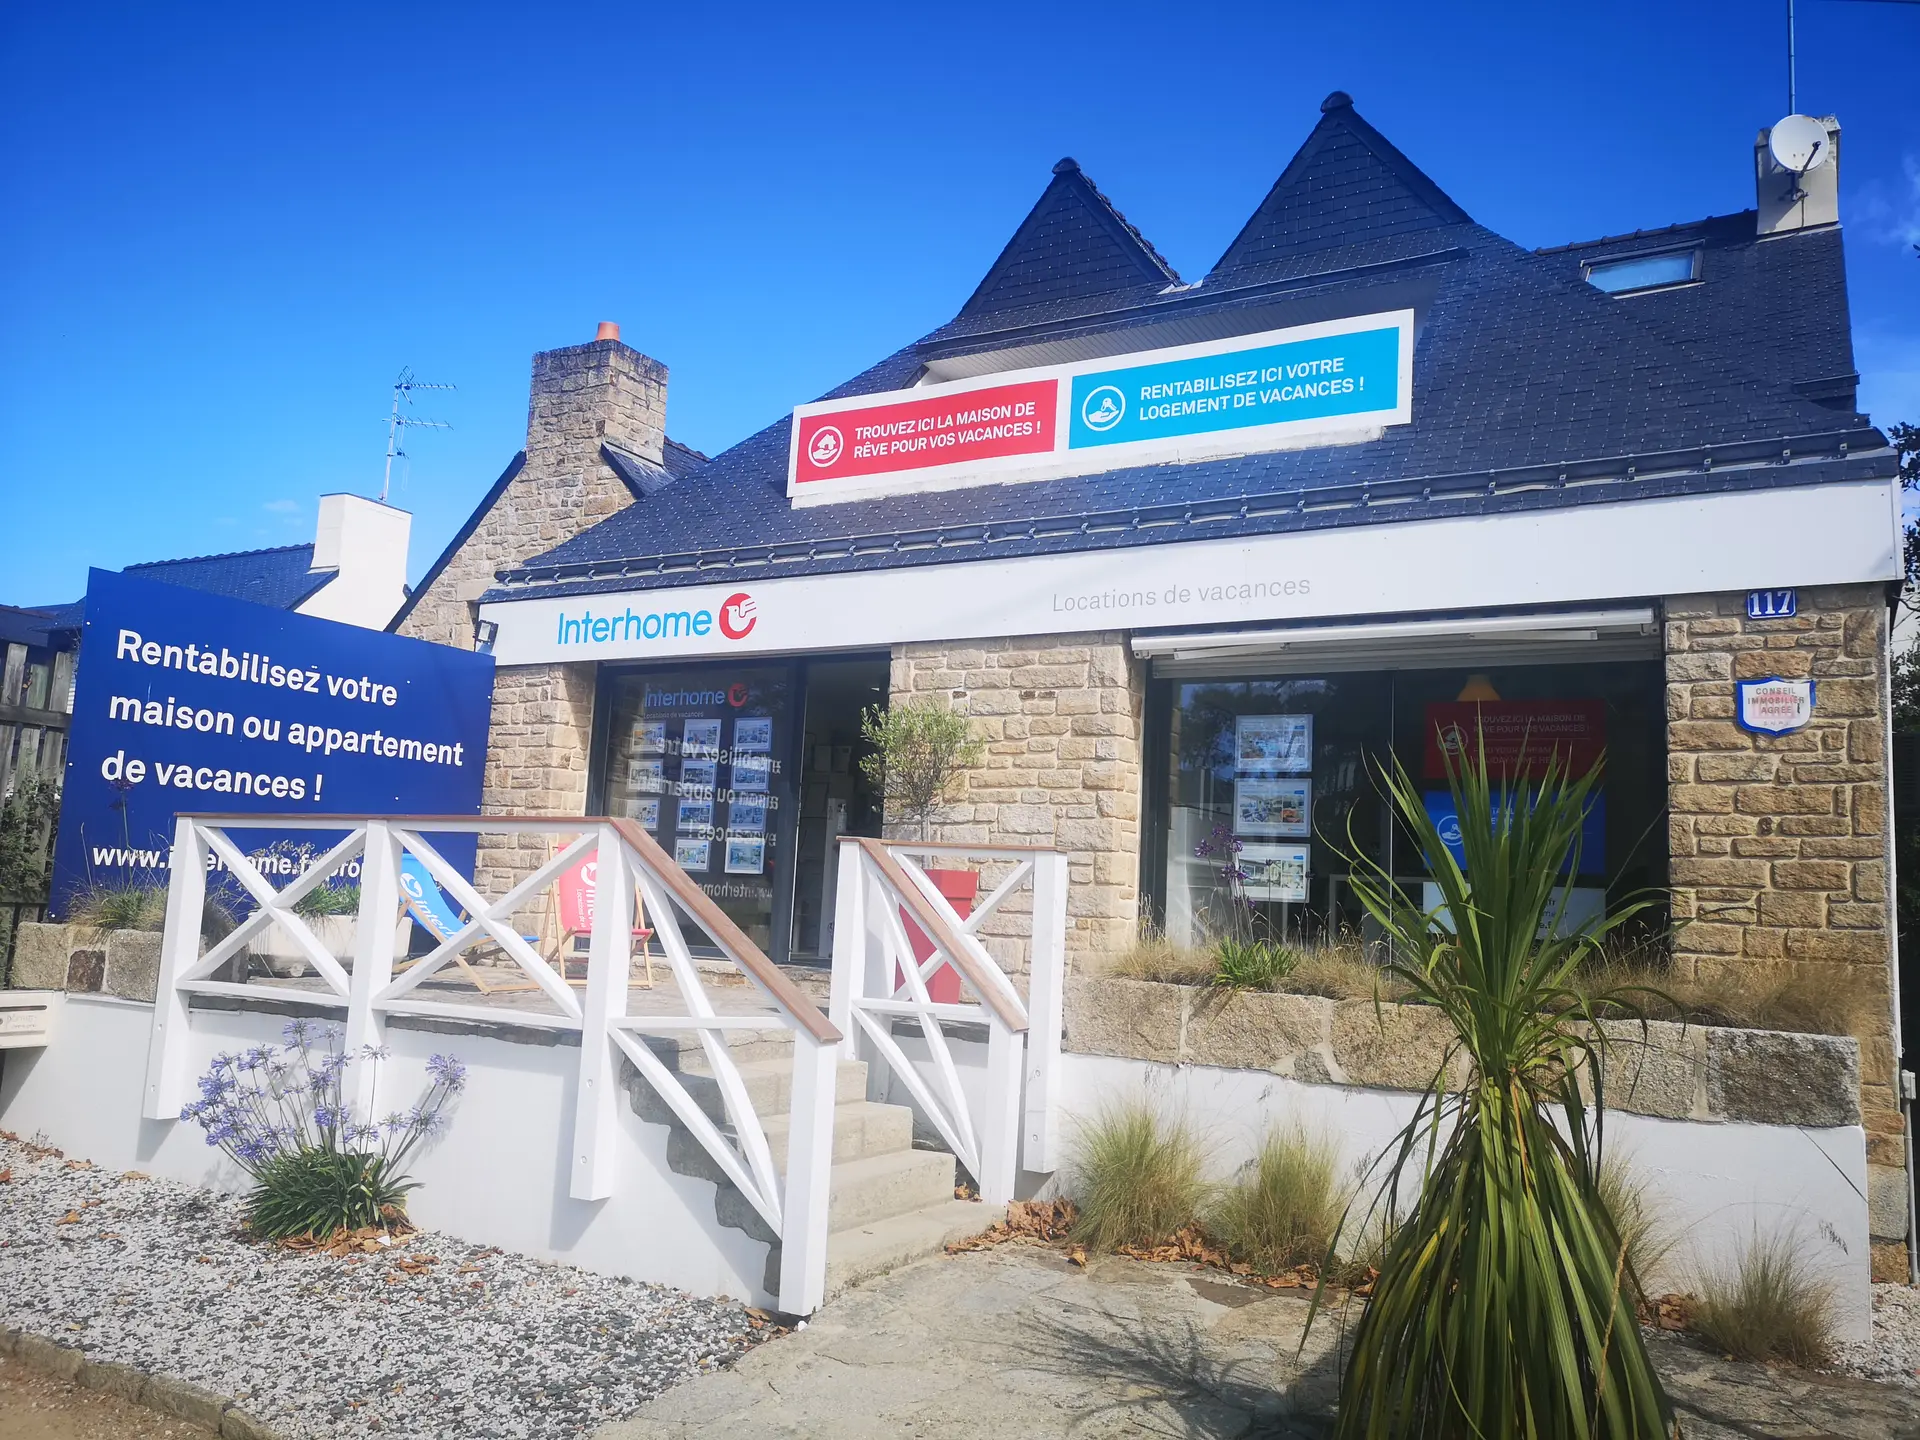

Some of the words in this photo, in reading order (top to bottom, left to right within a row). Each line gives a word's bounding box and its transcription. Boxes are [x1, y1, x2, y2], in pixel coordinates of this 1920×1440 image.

[1140, 370, 1258, 400] RENTABILISEZ
[1261, 366, 1282, 383] ICI
[1286, 357, 1344, 379] VOTRE
[1139, 395, 1230, 421] LOGEMENT
[1233, 392, 1256, 408] DE
[1259, 377, 1354, 404] VACANCES
[1359, 376, 1365, 391] !
[853, 441, 888, 459] RÊVE
[891, 436, 927, 454] POUR
[929, 432, 955, 449] VOS
[957, 421, 1032, 444] VACANCES
[1036, 420, 1042, 434] !
[855, 420, 916, 440] TROUVEZ
[918, 417, 934, 432] ICI
[937, 414, 953, 429] LA
[956, 405, 1012, 425] MAISON
[1014, 401, 1036, 416] DE
[1053, 589, 1157, 612] Locations
[1164, 584, 1191, 605] de
[1198, 579, 1311, 602] vacances
[1750, 590, 1792, 615] 117
[557, 607, 712, 645] Interhome
[116, 629, 320, 694] Rentabilisez
[327, 674, 398, 707] votre
[1747, 695, 1805, 705] IMMOBILIER
[1755, 687, 1796, 695] CONSEIL
[109, 695, 235, 735] maison
[243, 714, 280, 741] ou
[288, 721, 464, 767] appartement
[1473, 715, 1511, 723] TOUVEZ
[101, 750, 146, 784] de
[155, 762, 306, 800] vacances
[313, 774, 323, 802] !
